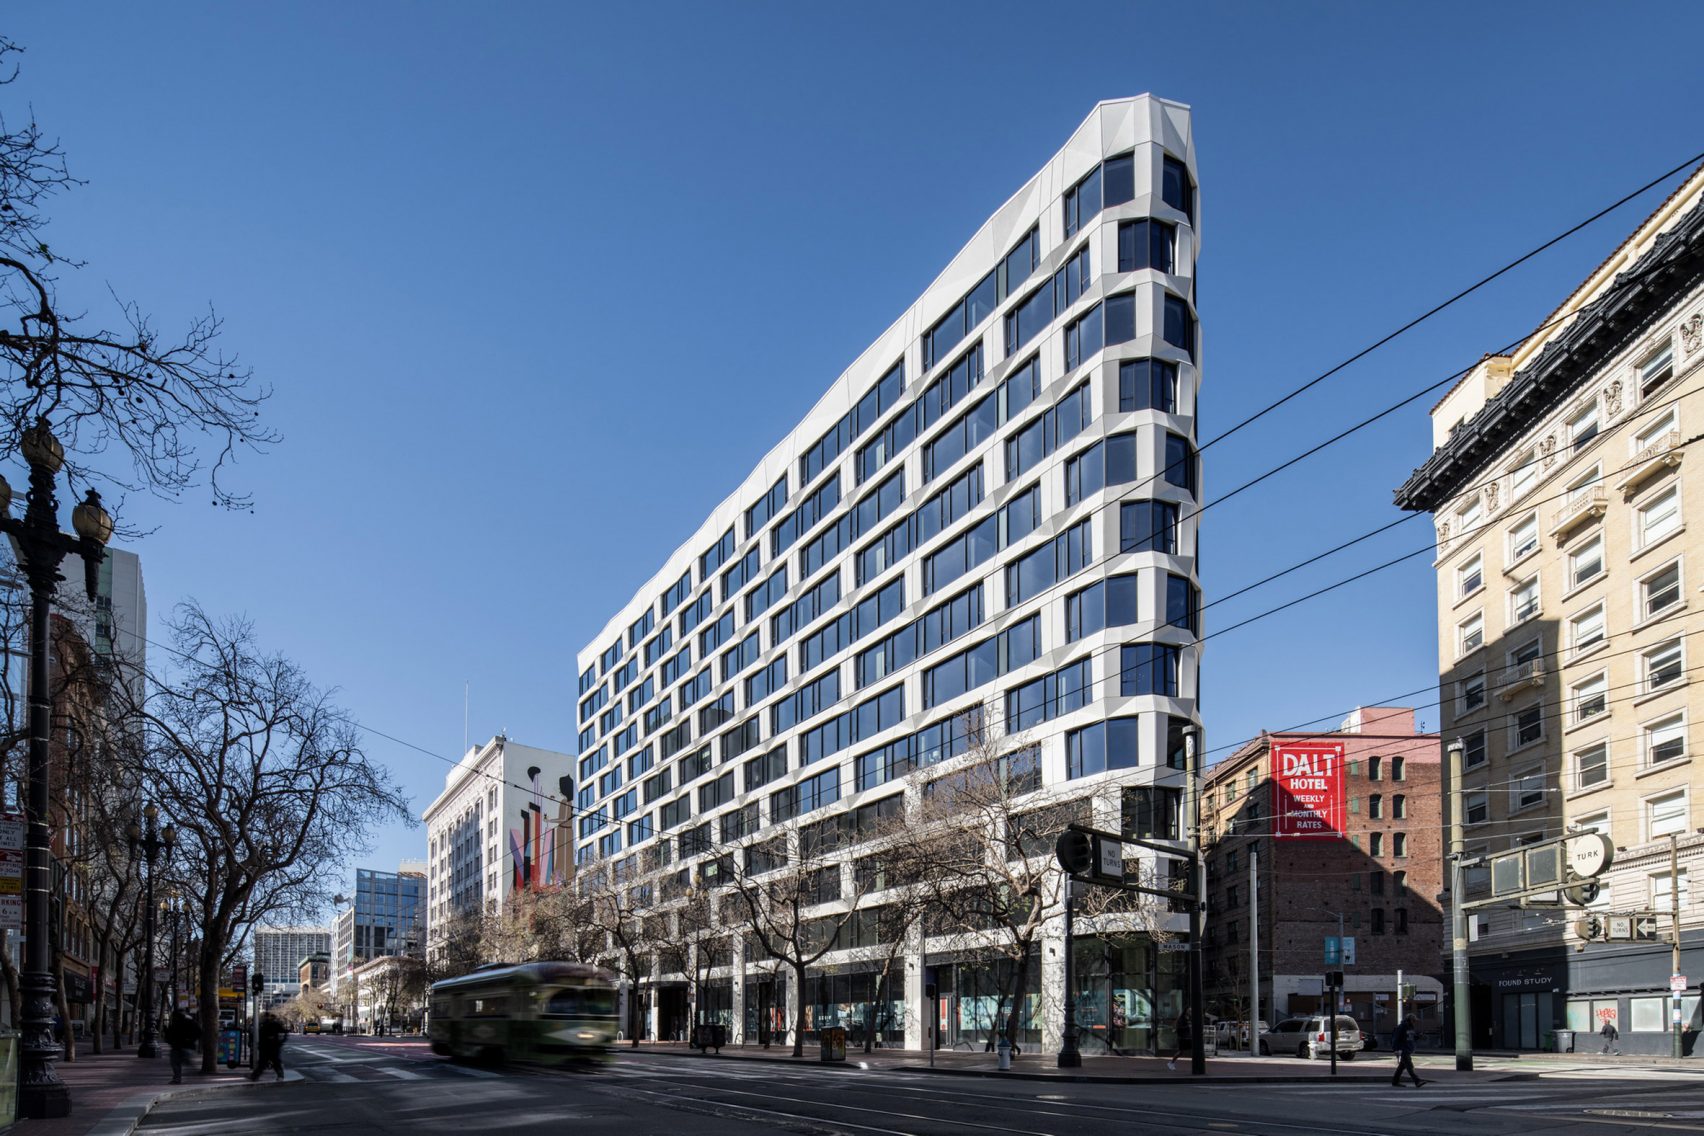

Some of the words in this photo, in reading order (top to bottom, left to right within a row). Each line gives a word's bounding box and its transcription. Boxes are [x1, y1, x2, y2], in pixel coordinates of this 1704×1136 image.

[1283, 753, 1336, 776] DALT
[1290, 779, 1328, 790] HOTEL
[1293, 794, 1325, 803] WEEKLY
[1292, 810, 1328, 818] MONTHLY
[1296, 821, 1322, 829] RATES
[1107, 849, 1116, 858] NO
[1577, 850, 1599, 861] TURK
[1103, 857, 1121, 868] TURNS
[1498, 979, 1522, 987] FOUND
[1524, 976, 1553, 985] STUDY
